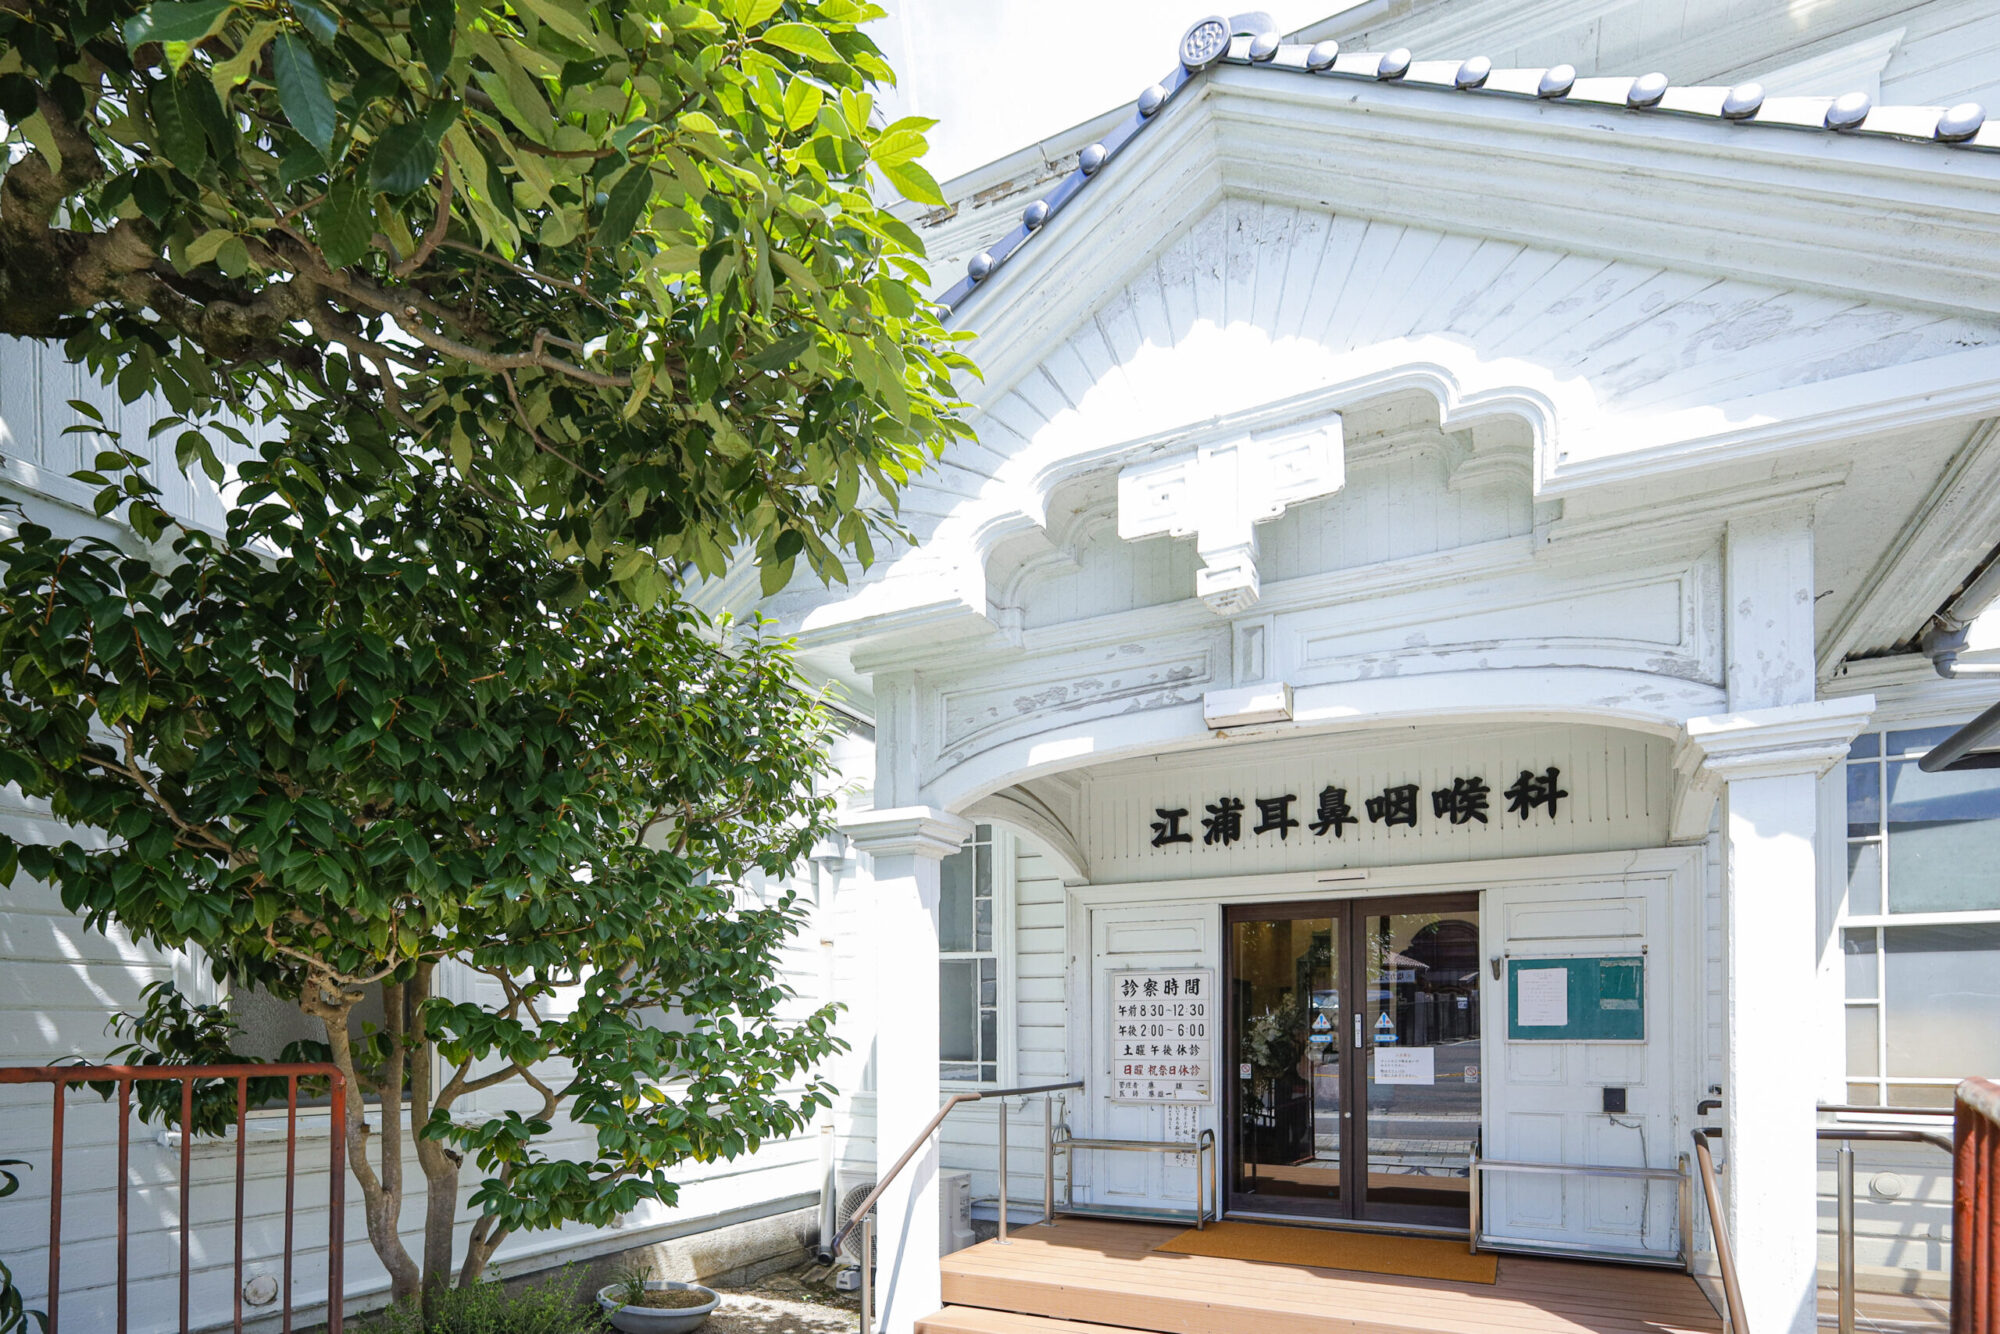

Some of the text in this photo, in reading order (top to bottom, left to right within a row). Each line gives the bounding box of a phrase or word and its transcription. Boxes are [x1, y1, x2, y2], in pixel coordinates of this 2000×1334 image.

[1150, 766, 1568, 848] 江浦耳鼻咽喉科
[1121, 978, 1200, 998] 診察時間
